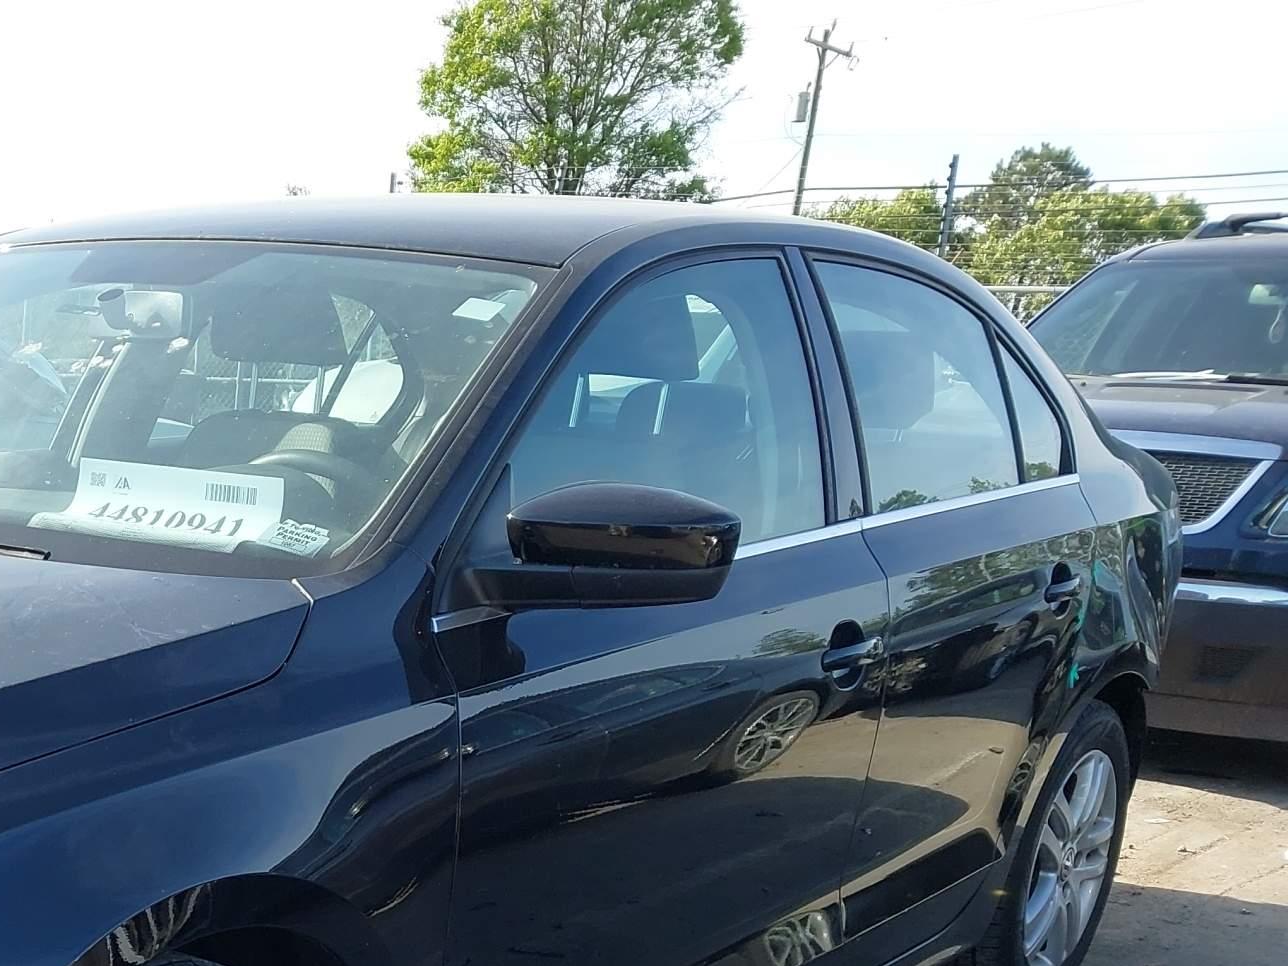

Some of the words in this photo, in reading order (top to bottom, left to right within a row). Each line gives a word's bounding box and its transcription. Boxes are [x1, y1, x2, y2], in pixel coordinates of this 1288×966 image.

[88, 502, 244, 537] 44810941
[276, 532, 311, 546] PERMIT
[277, 526, 318, 542] PARKING
